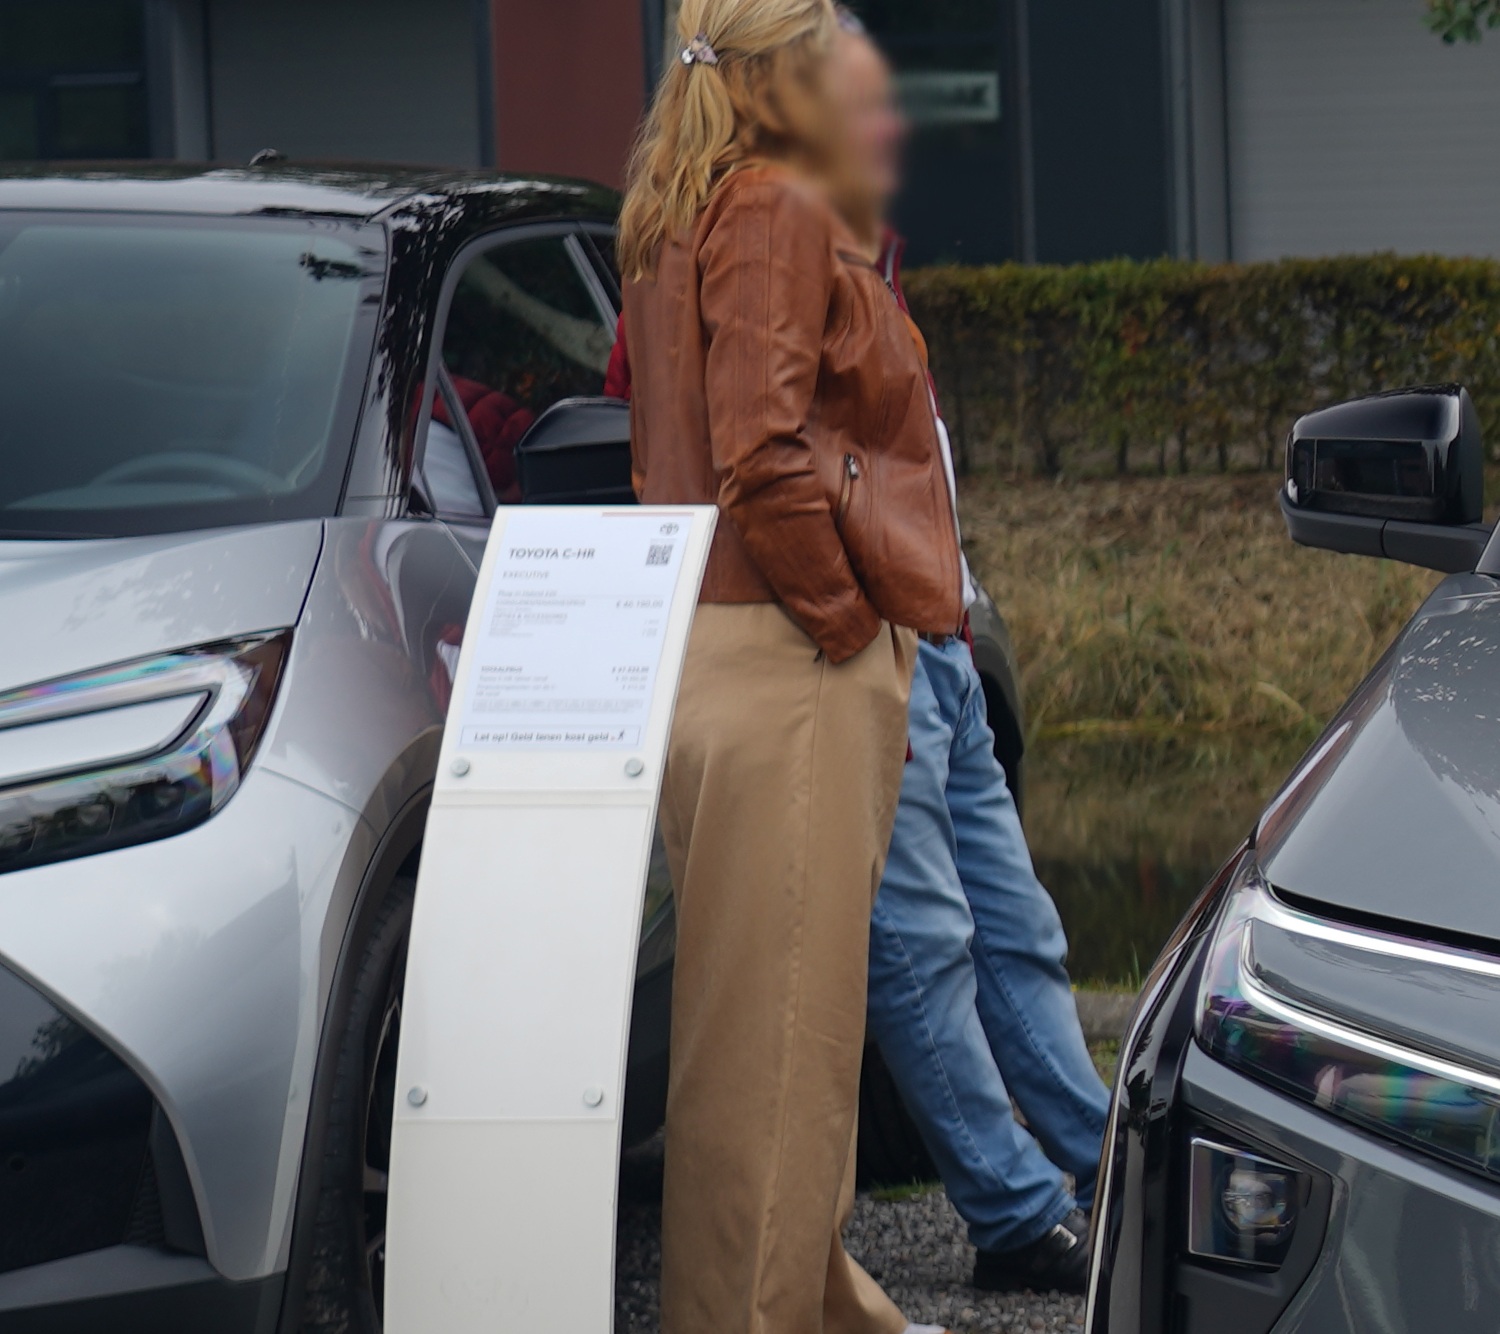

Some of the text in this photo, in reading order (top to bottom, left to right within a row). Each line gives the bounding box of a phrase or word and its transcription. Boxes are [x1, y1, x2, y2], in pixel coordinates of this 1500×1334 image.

[509, 548, 596, 560] TOYOTA C-HR
[503, 570, 549, 579] EXECUTIVE
[474, 732, 490, 742] Let
[510, 732, 534, 742] Geld
[536, 732, 562, 742] lenen
[565, 732, 586, 742] kost
[587, 732, 609, 744] geld
